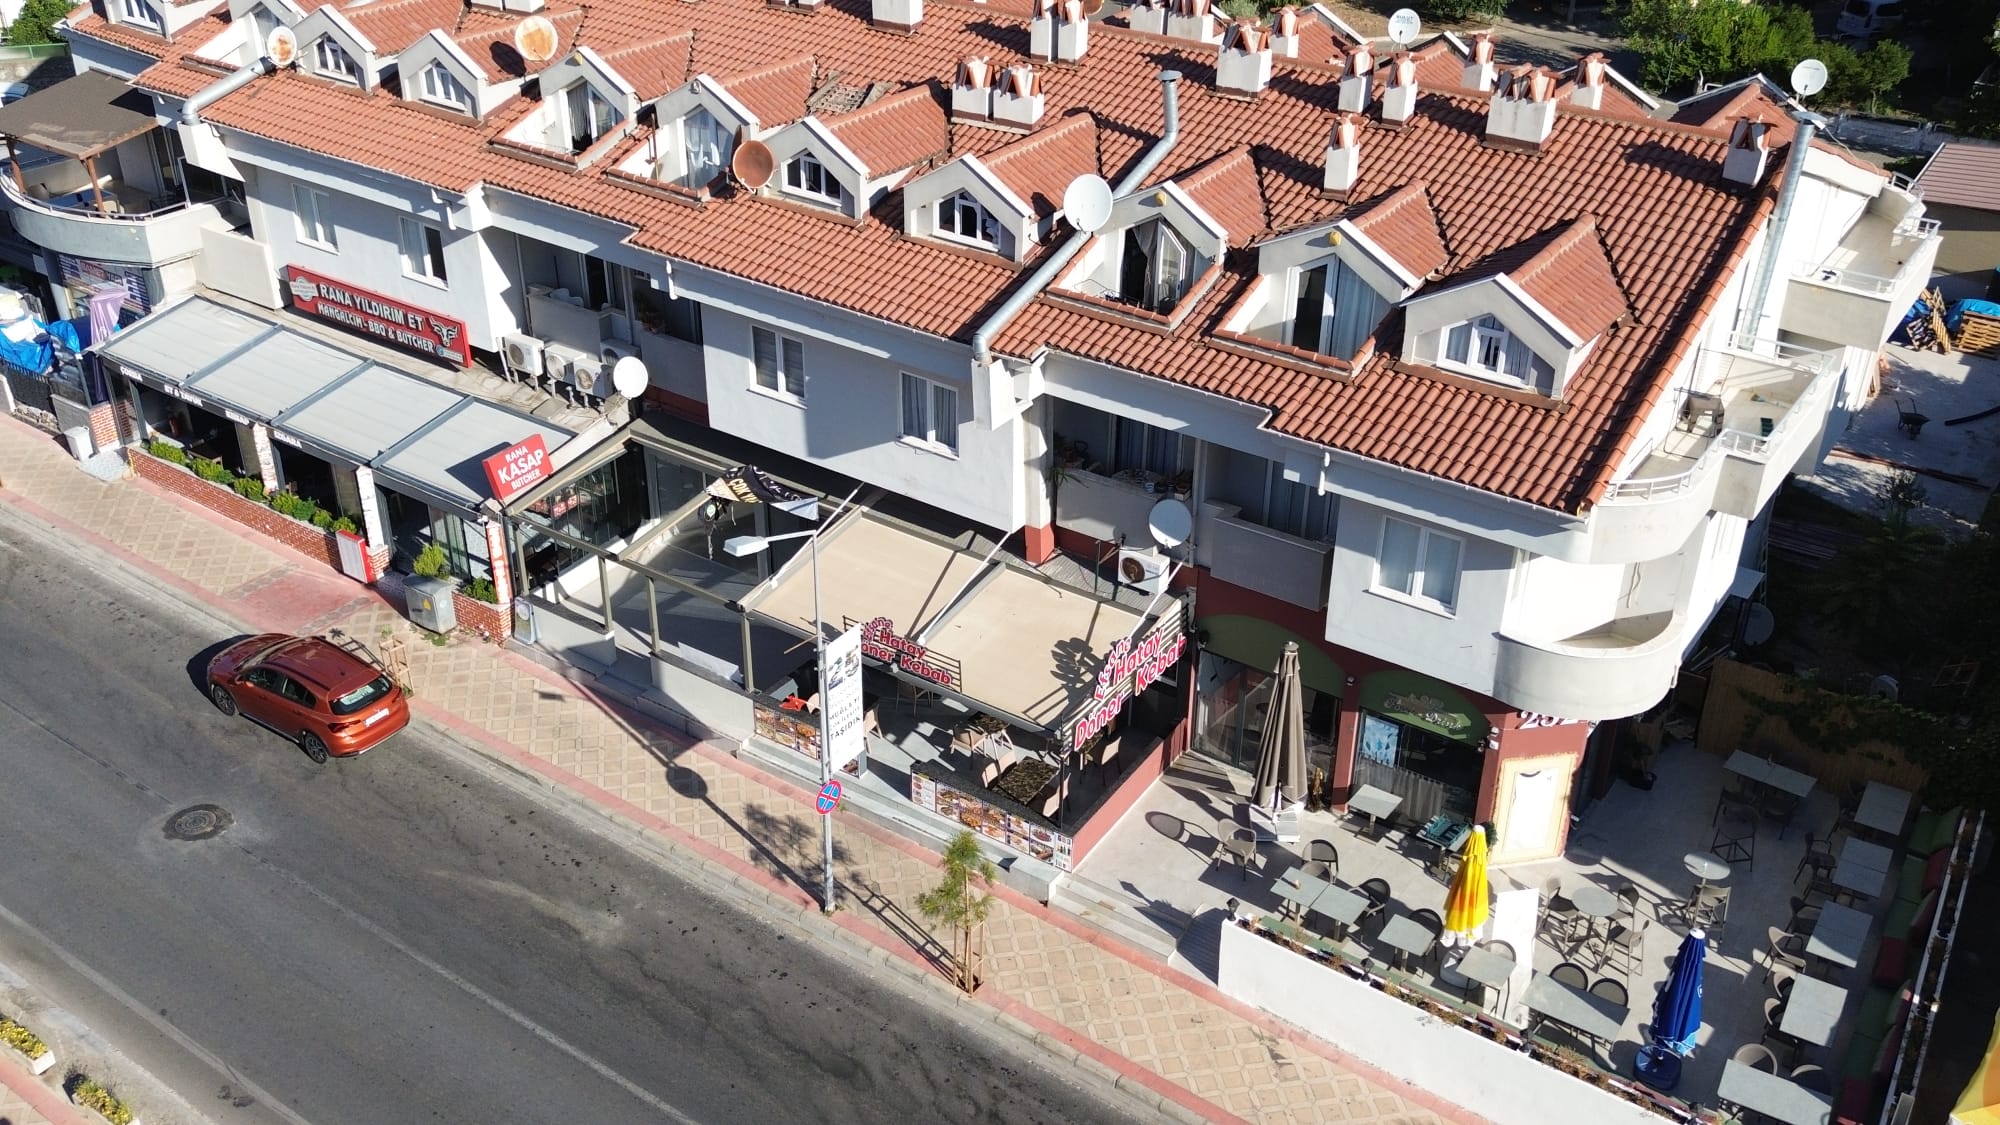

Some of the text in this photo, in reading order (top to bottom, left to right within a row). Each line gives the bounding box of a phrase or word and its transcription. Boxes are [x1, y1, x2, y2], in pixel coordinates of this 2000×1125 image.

[319, 283, 353, 307] RANA
[353, 295, 404, 324] YILDIRIM
[408, 313, 424, 331] ET
[396, 331, 435, 354] BUTCHER
[498, 448, 544, 485] KASAP
[504, 445, 529, 463] RANA
[511, 468, 542, 490] BUTCHER
[879, 630, 928, 661] Hatay
[1113, 628, 1164, 687] Hatay
[901, 655, 953, 686] Kebab
[1074, 690, 1126, 751] Döner
